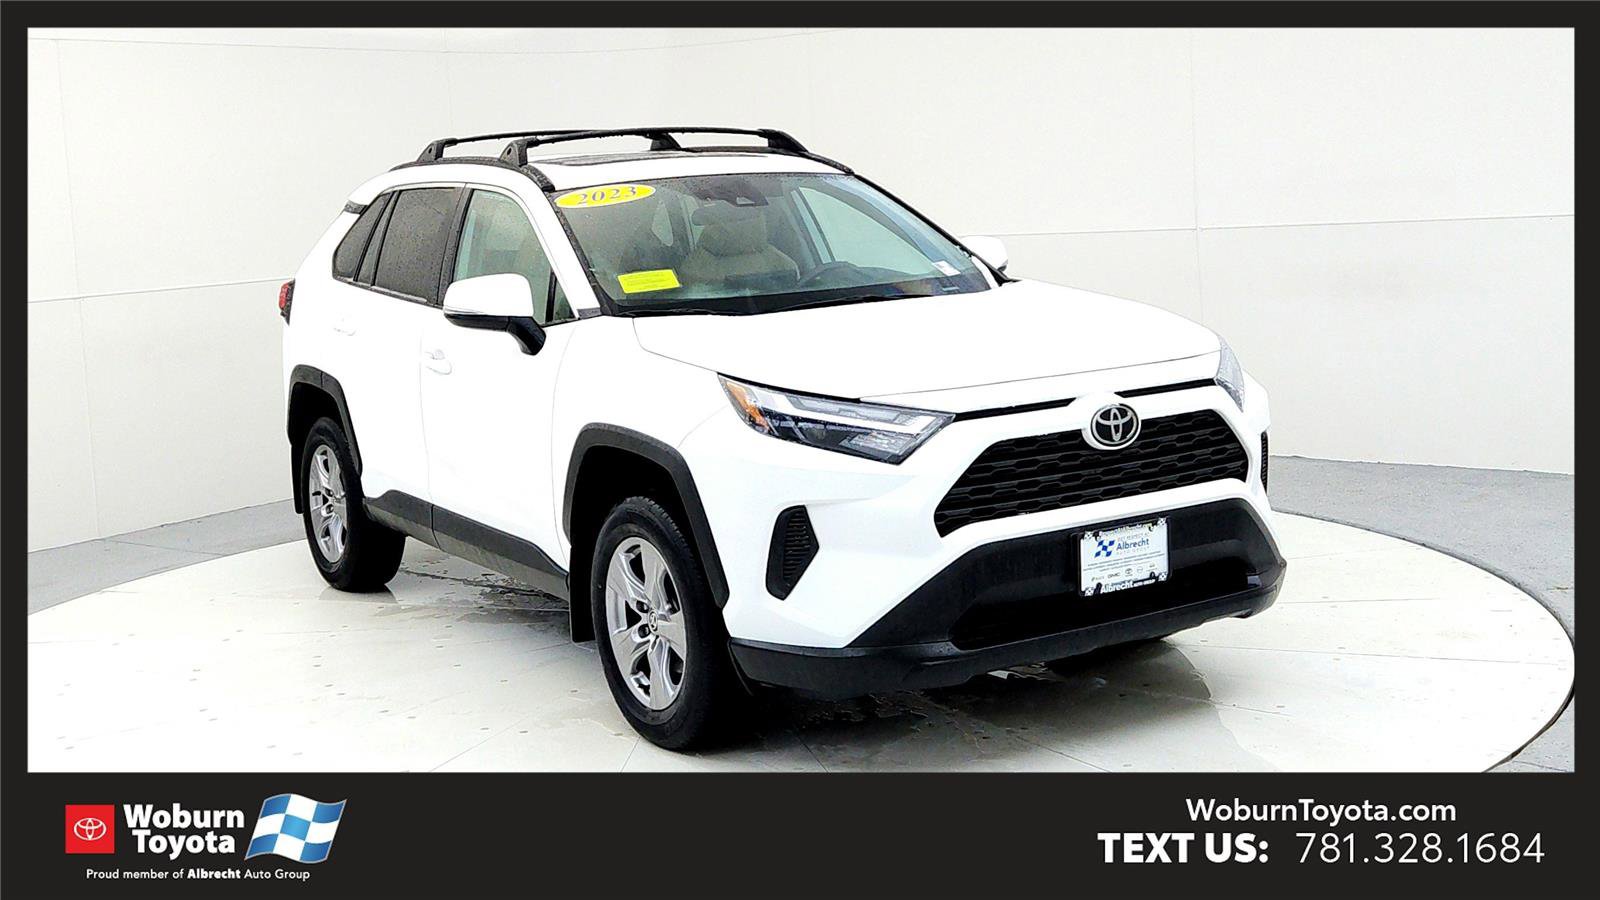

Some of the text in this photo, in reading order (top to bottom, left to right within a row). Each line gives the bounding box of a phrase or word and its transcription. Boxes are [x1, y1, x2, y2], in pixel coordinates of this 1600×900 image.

[577, 186, 637, 204] 2023
[1116, 537, 1149, 551] Albrecht
[1100, 580, 1134, 594] Albrecht
